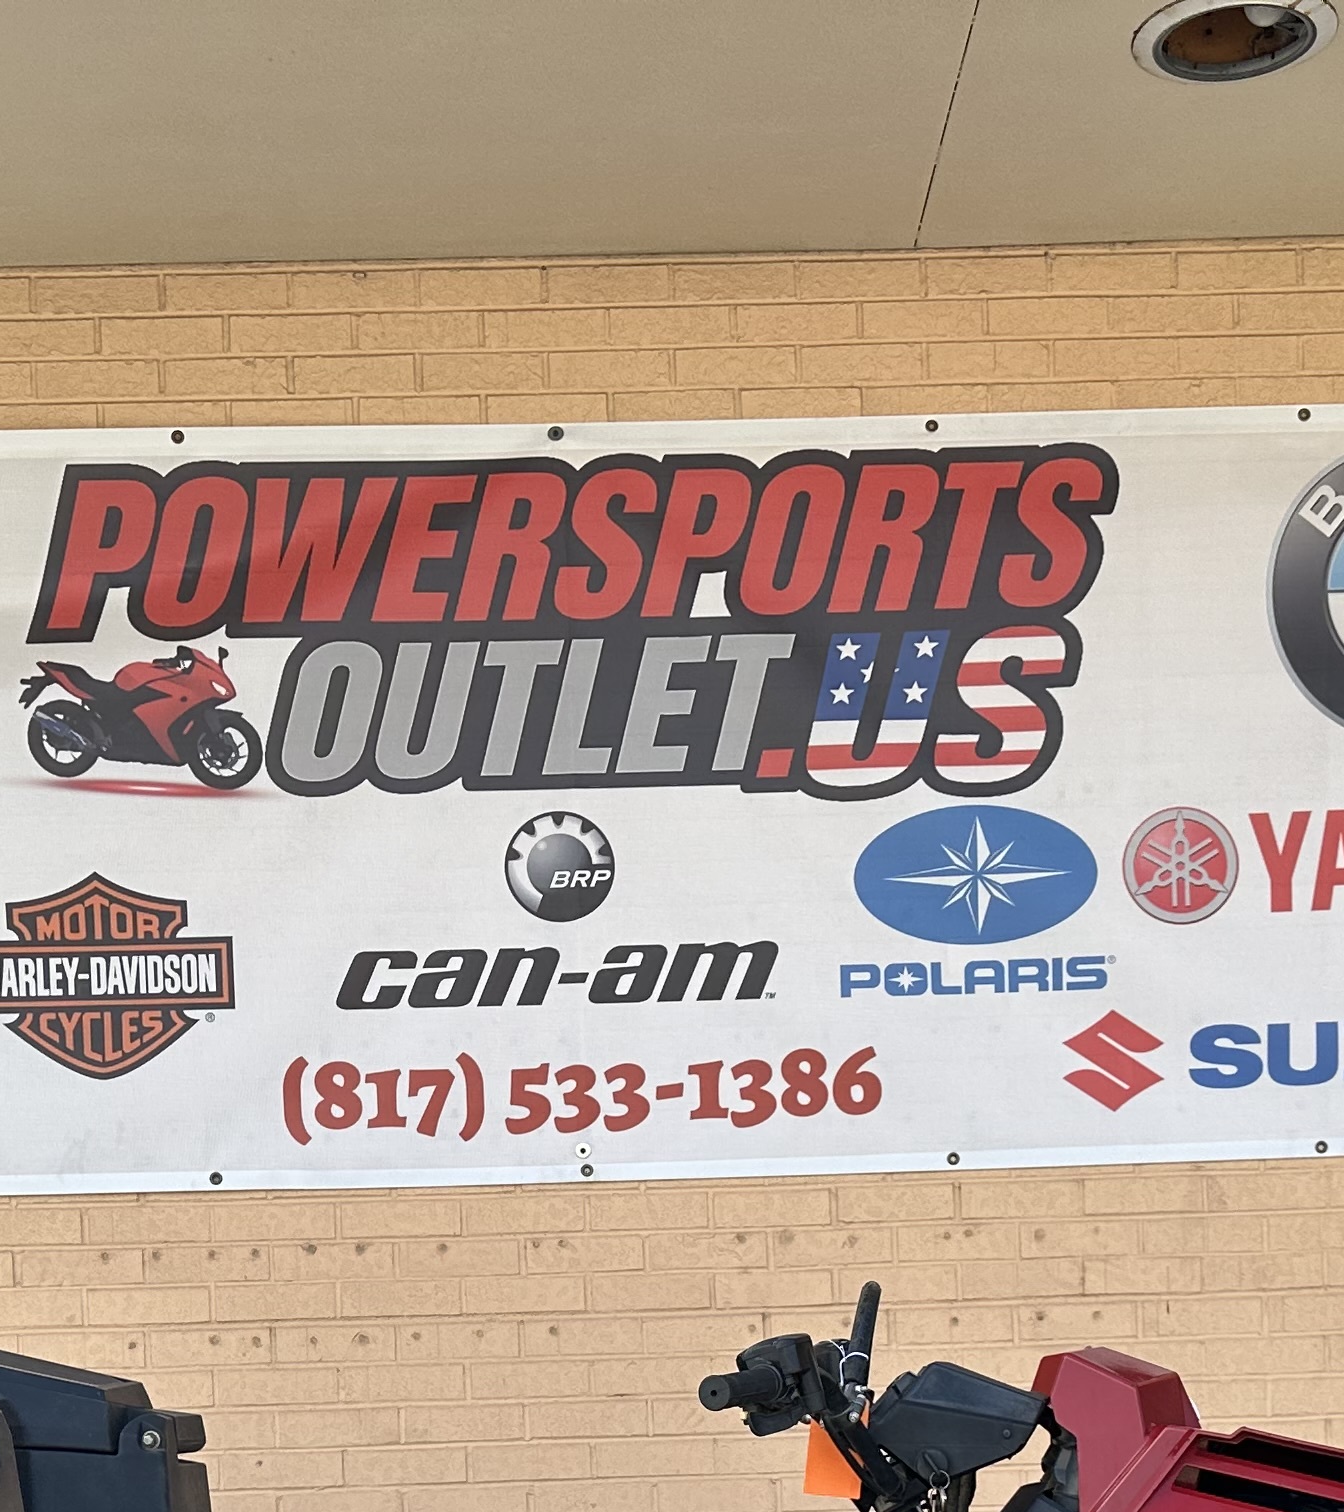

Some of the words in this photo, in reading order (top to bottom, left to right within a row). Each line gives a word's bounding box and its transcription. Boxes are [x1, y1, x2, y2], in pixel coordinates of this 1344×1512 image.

[46, 457, 1105, 632] POWERSPORTS
[279, 626, 1066, 784] OUTLET.US
[549, 869, 612, 889] BRP
[36, 894, 160, 941] MOTOR
[335, 940, 780, 1011] can-am
[839, 955, 1107, 998] POLARIS
[39, 1010, 163, 1063] CYCLES
[282, 1055, 484, 1145] (817)
[506, 1048, 882, 1134] 533-1386
